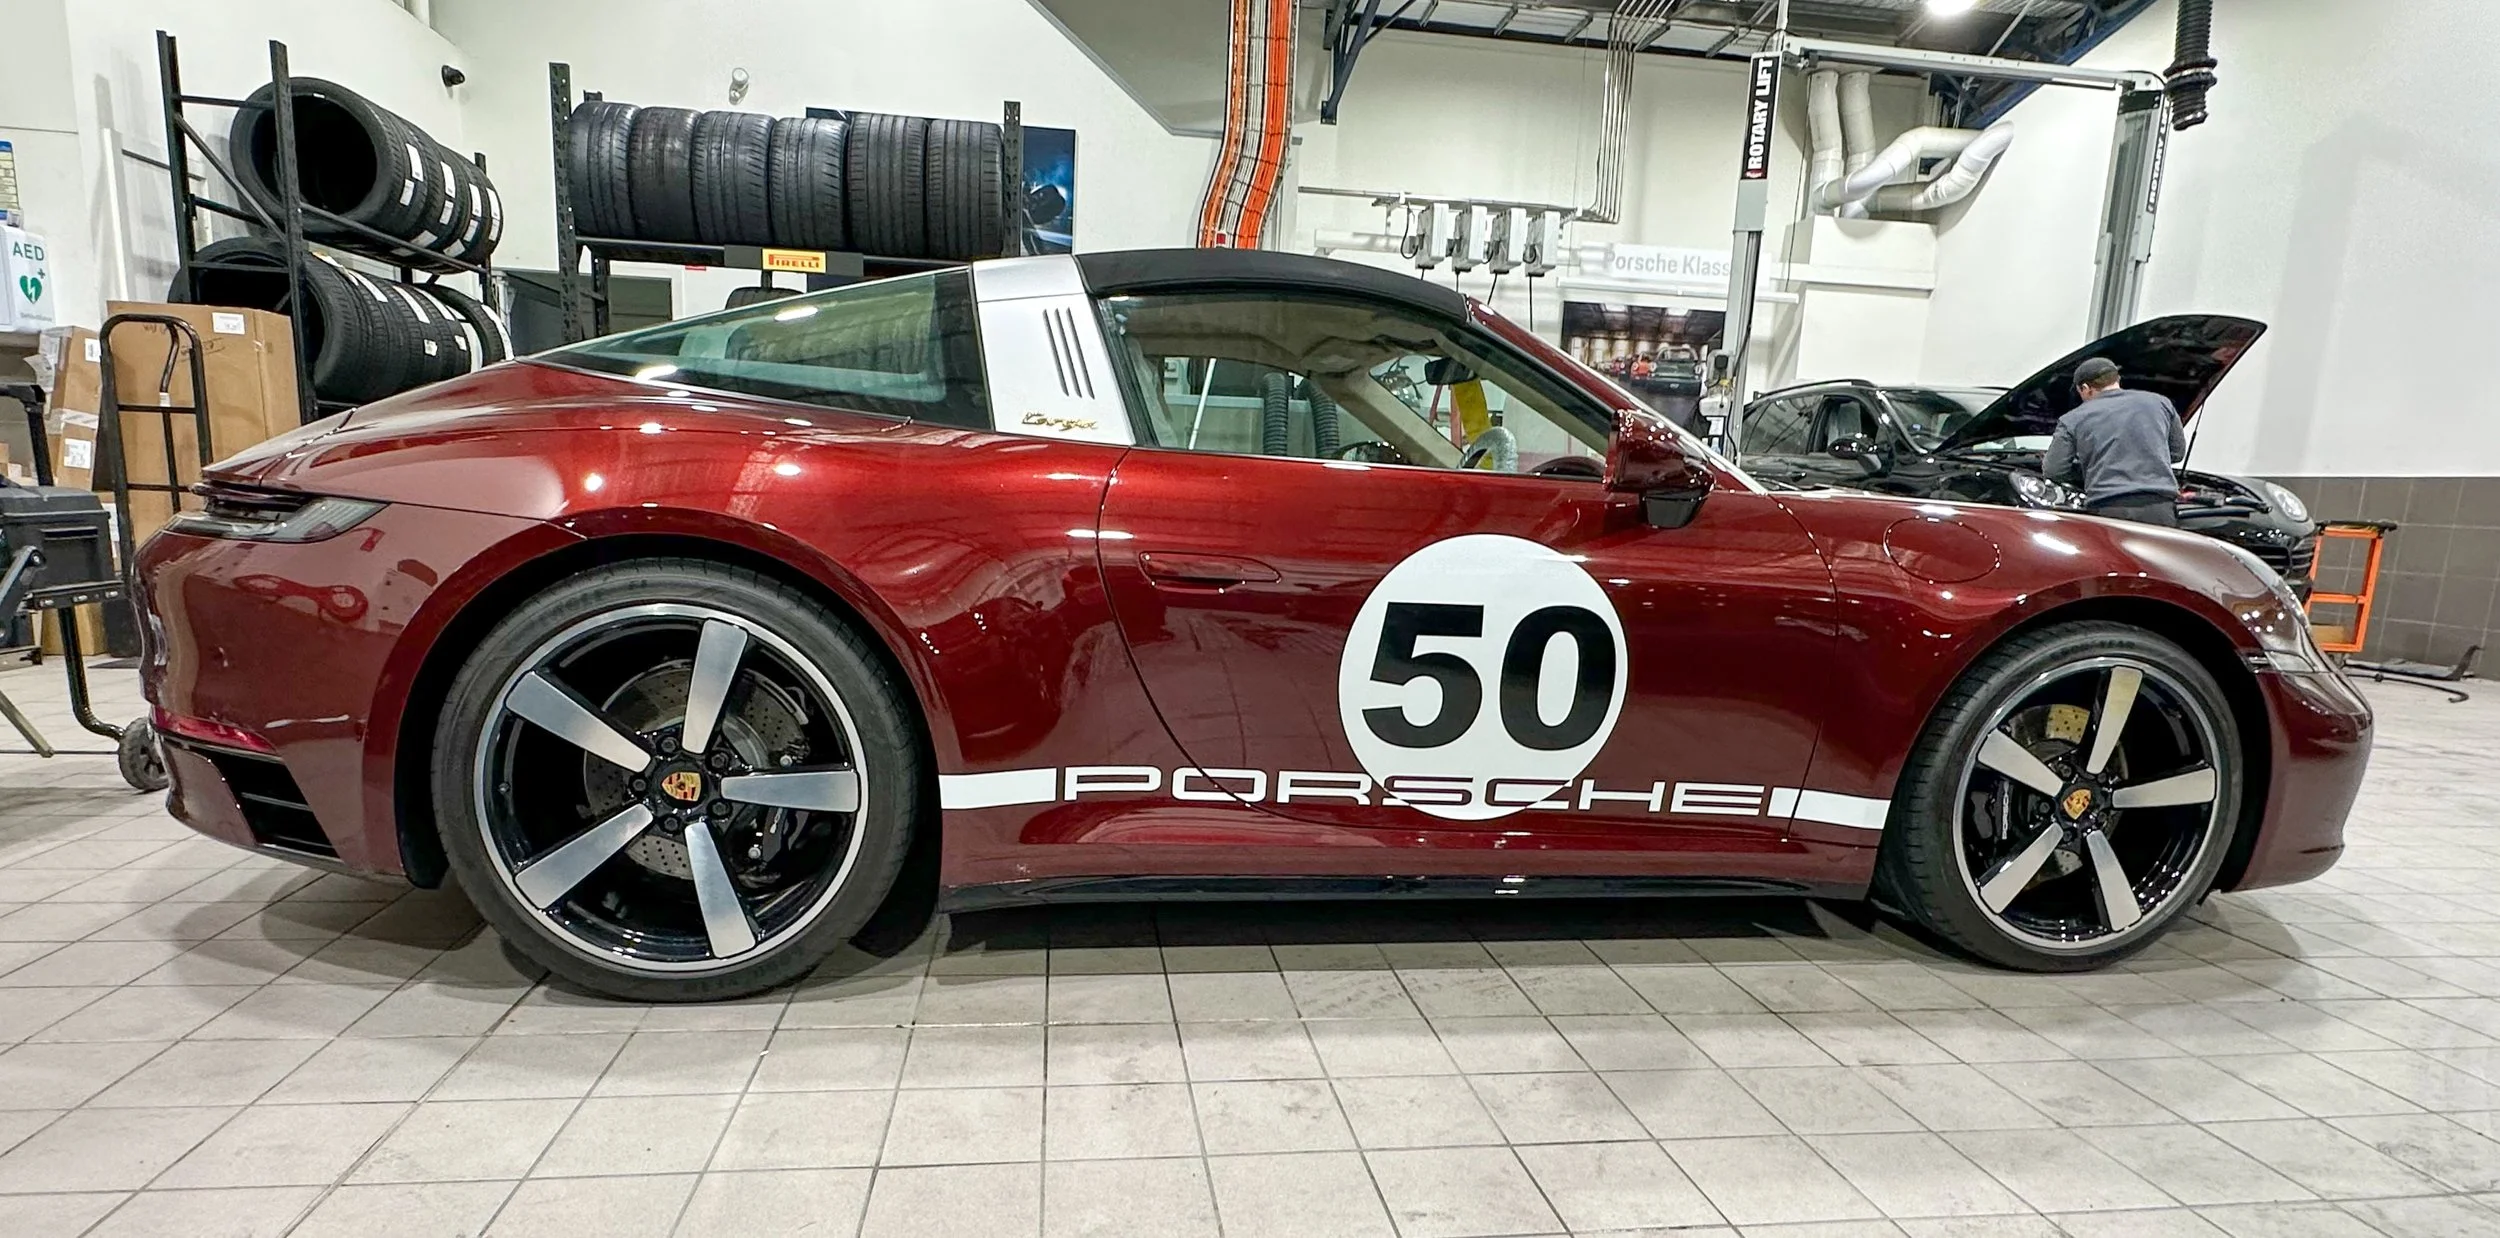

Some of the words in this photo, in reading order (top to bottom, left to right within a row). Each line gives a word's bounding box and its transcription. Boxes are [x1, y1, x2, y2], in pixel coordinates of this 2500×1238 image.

[1755, 58, 1773, 97] LIFT
[1747, 99, 1769, 169] ROTARY
[2148, 136, 2164, 204] ROTARY
[13, 241, 45, 261] AED
[768, 253, 820, 268] PIRELLI
[1603, 249, 1678, 274] Porsche
[1682, 254, 1730, 277] Klass
[1361, 601, 1617, 751] 50
[1063, 765, 1765, 816] PORSCHE
